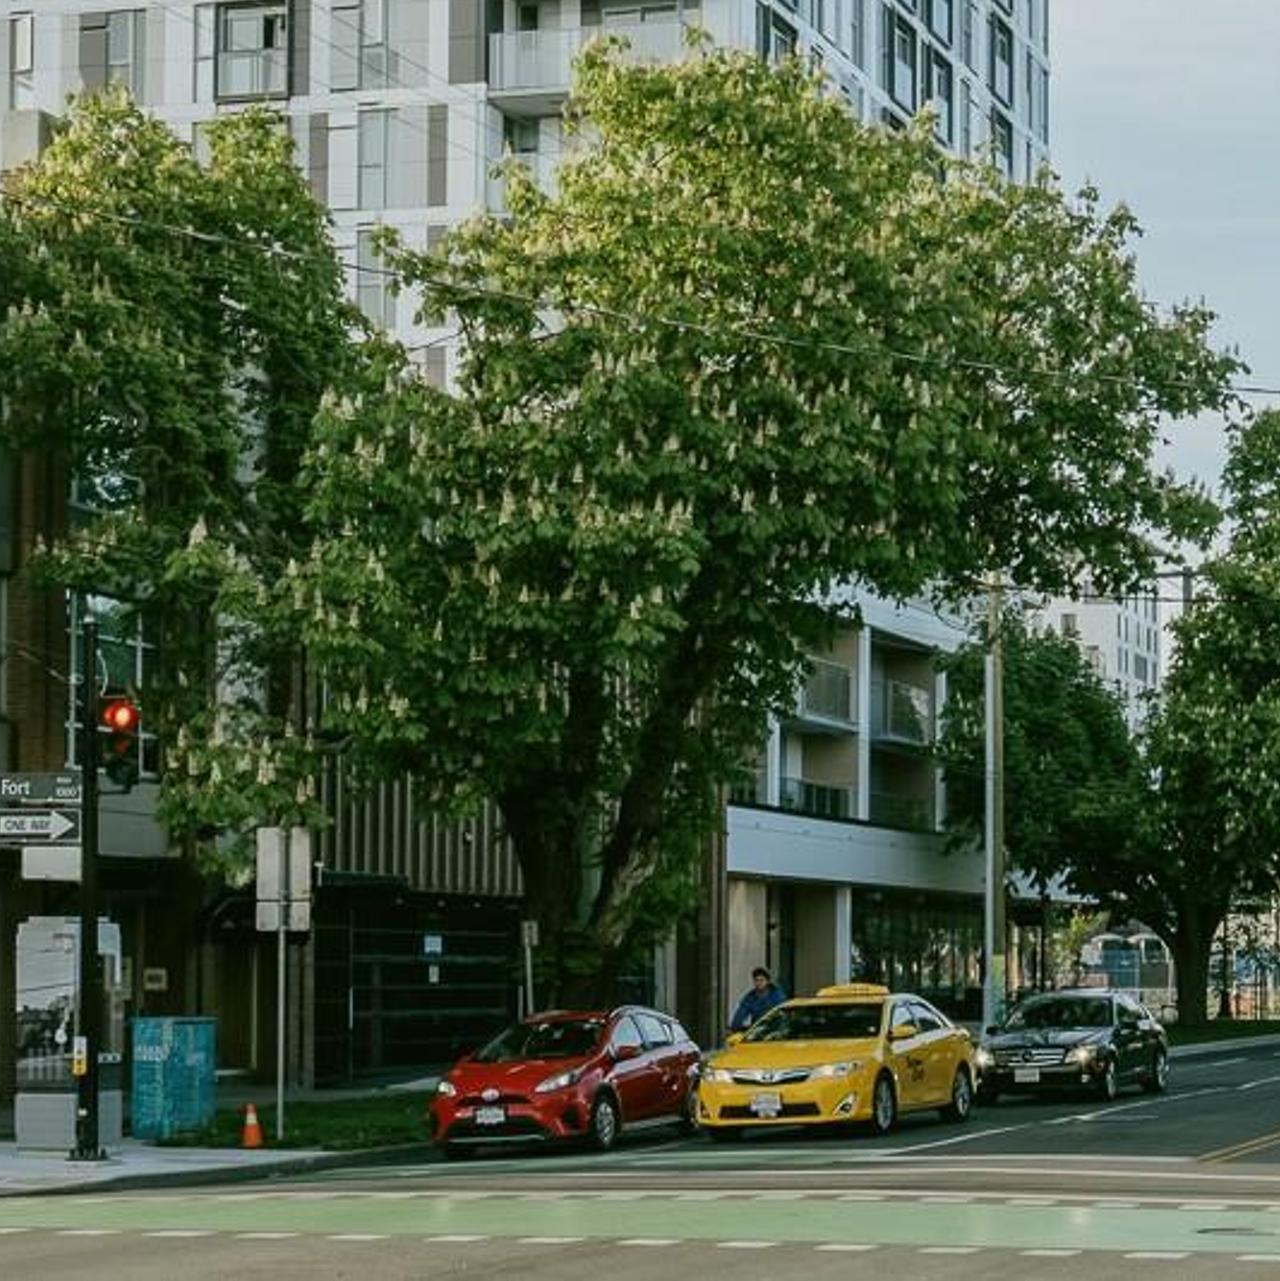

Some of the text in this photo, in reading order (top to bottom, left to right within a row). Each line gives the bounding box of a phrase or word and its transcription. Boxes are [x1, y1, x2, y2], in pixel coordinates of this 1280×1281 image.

[1, 779, 30, 796] Fort
[4, 819, 52, 832] ONE WAY
